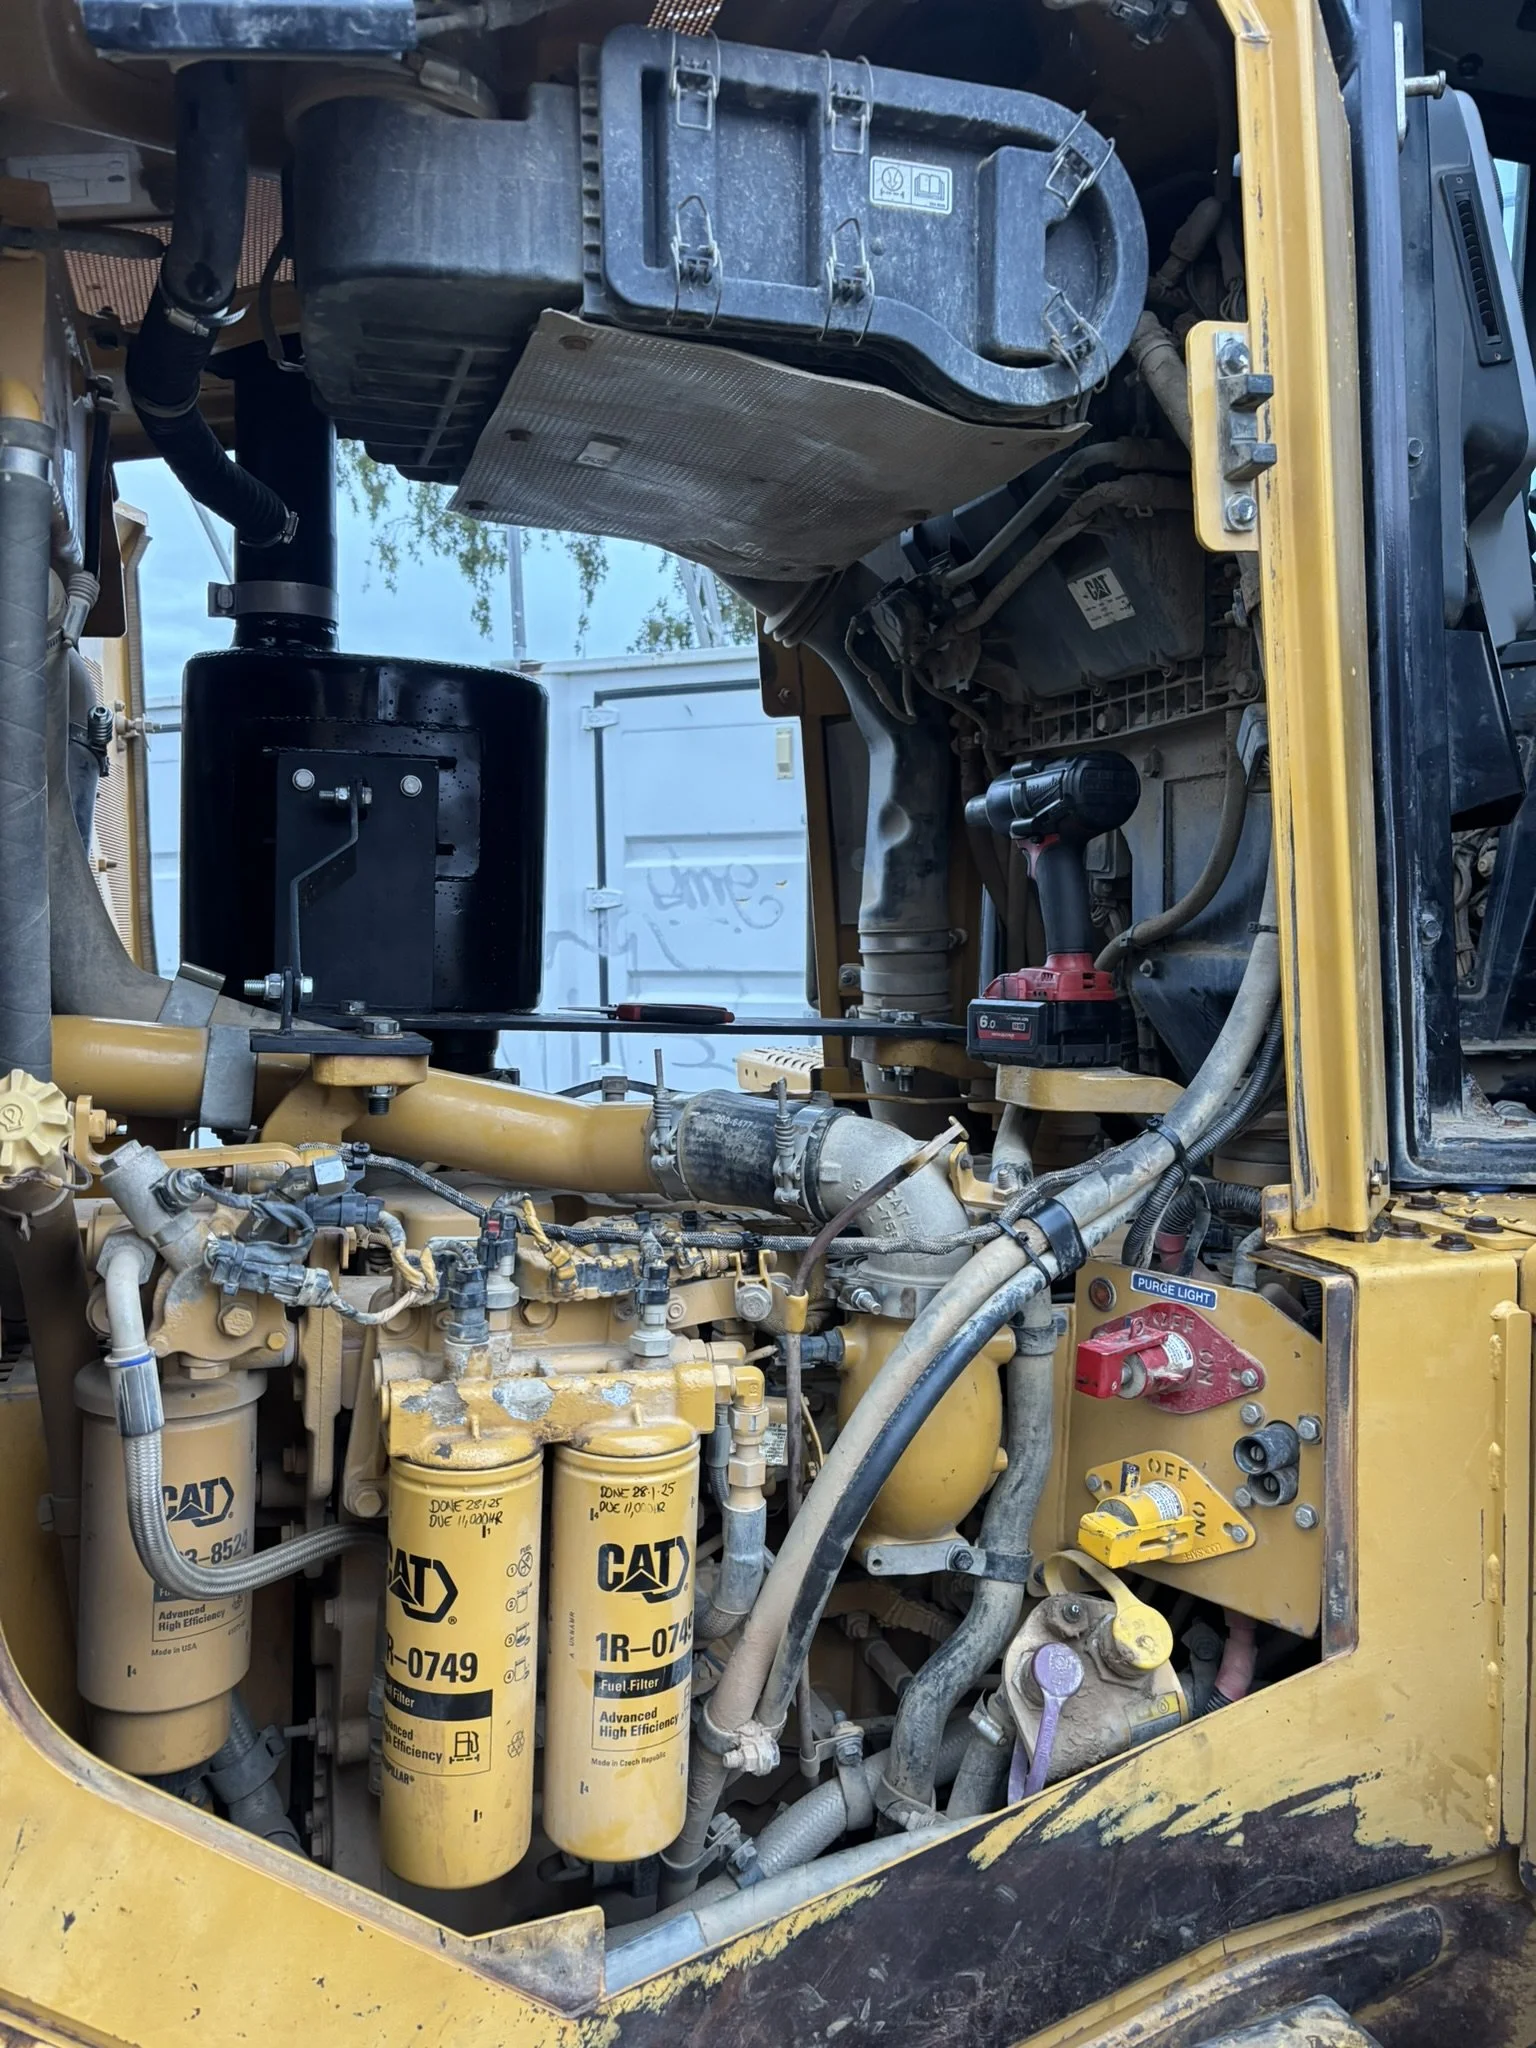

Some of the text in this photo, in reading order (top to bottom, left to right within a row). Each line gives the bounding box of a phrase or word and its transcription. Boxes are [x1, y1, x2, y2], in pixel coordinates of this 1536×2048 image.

[1084, 574, 1112, 600] CAT
[980, 1015, 996, 1029] 6.0
[714, 1114, 753, 1129] 209-6477
[1137, 1277, 1211, 1304] PURGE LIGHT
[1148, 1457, 1189, 1482] OFF
[162, 1478, 219, 1522] CAT
[600, 1486, 629, 1499] DONE
[429, 1500, 463, 1513] DONE
[600, 1501, 621, 1513] DUE
[429, 1514, 452, 1528] DUE
[1192, 1501, 1206, 1537] ON
[597, 1537, 676, 1593] CAT
[158, 1622, 181, 1632] High
[183, 1609, 226, 1628] Efficiency
[159, 1604, 206, 1620] Advanced
[151, 1648, 172, 1656] Made
[182, 1643, 198, 1651] USA
[601, 1678, 660, 1693] Fuel Filter
[393, 1686, 415, 1708] Filter
[600, 1707, 658, 1724] Advanced
[600, 1713, 680, 1740] High Efficiency
[393, 1735, 443, 1764] Efficiency
[591, 1758, 610, 1767] Made
[619, 1758, 640, 1767] Czech
[641, 1751, 666, 1764] Republic
